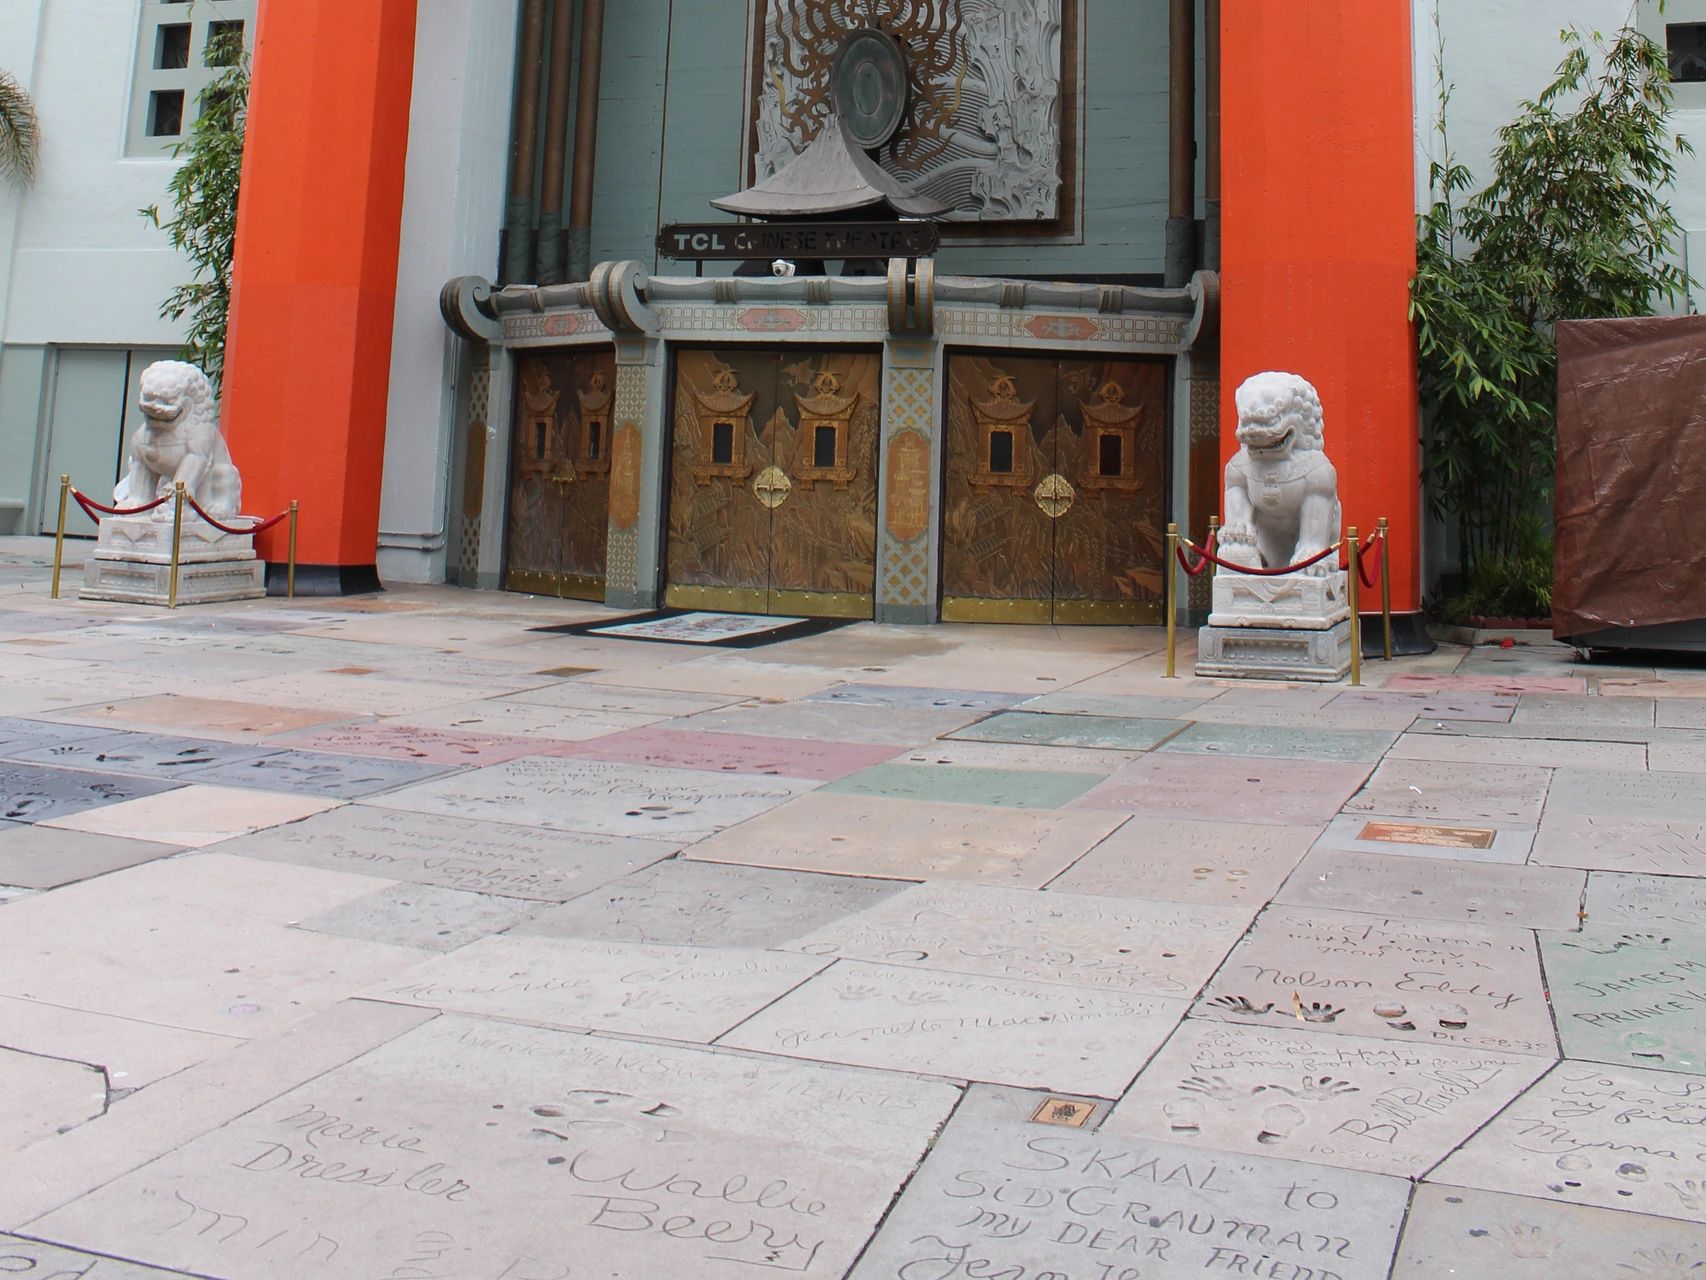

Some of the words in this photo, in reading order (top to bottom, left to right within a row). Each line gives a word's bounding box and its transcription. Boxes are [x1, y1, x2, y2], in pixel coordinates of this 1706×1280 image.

[673, 233, 725, 251] TCL
[1393, 971, 1524, 1010] Eddy
[1574, 970, 1686, 998] JAMES
[1572, 1001, 1695, 1029] PRINCE
[273, 1103, 427, 1154] Marie
[230, 1140, 471, 1202] Dressler
[568, 1148, 827, 1217] Wallie
[569, 1193, 826, 1272] Beery
[1046, 1221, 1172, 1262] DEAR
